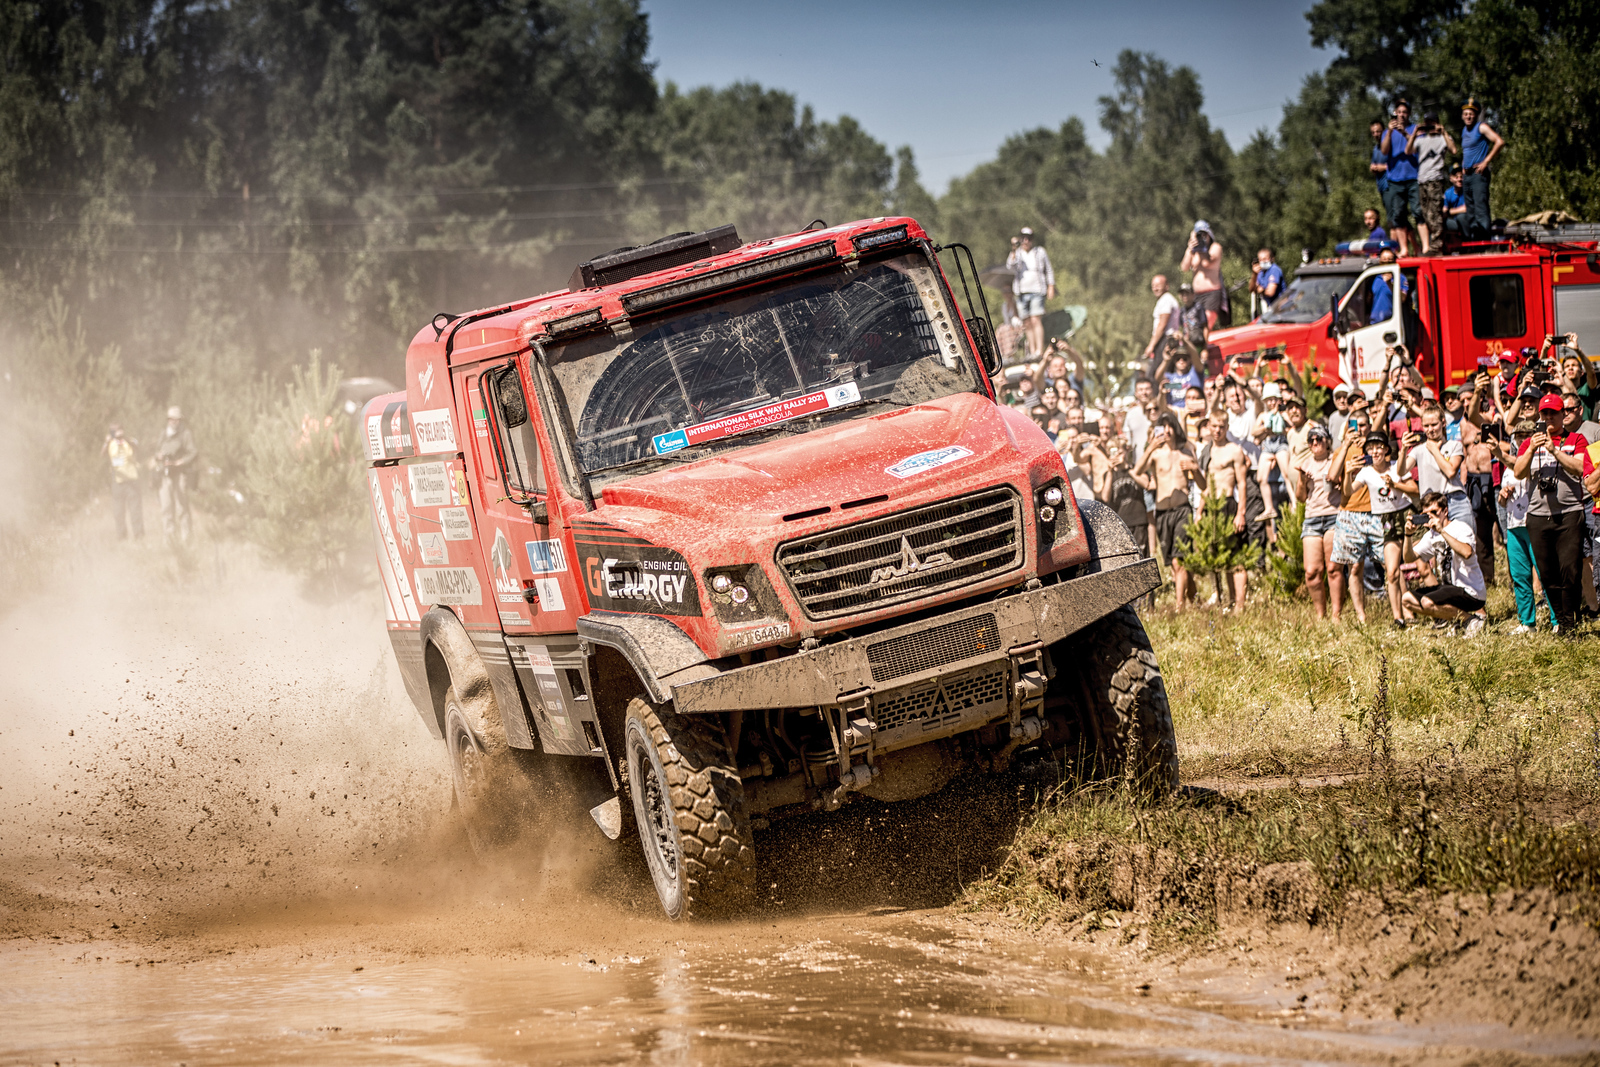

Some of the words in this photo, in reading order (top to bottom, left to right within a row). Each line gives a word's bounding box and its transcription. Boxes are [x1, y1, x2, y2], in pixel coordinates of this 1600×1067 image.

[1486, 340, 1503, 355] 30
[688, 414, 748, 436] INTERNATIONAL
[748, 409, 765, 420] SILK
[765, 405, 782, 416] WAY
[784, 399, 807, 411] RALLY
[808, 395, 824, 404] 2021
[548, 541, 566, 570] 511
[643, 561, 672, 571] ENGINE
[673, 561, 688, 571] OIL
